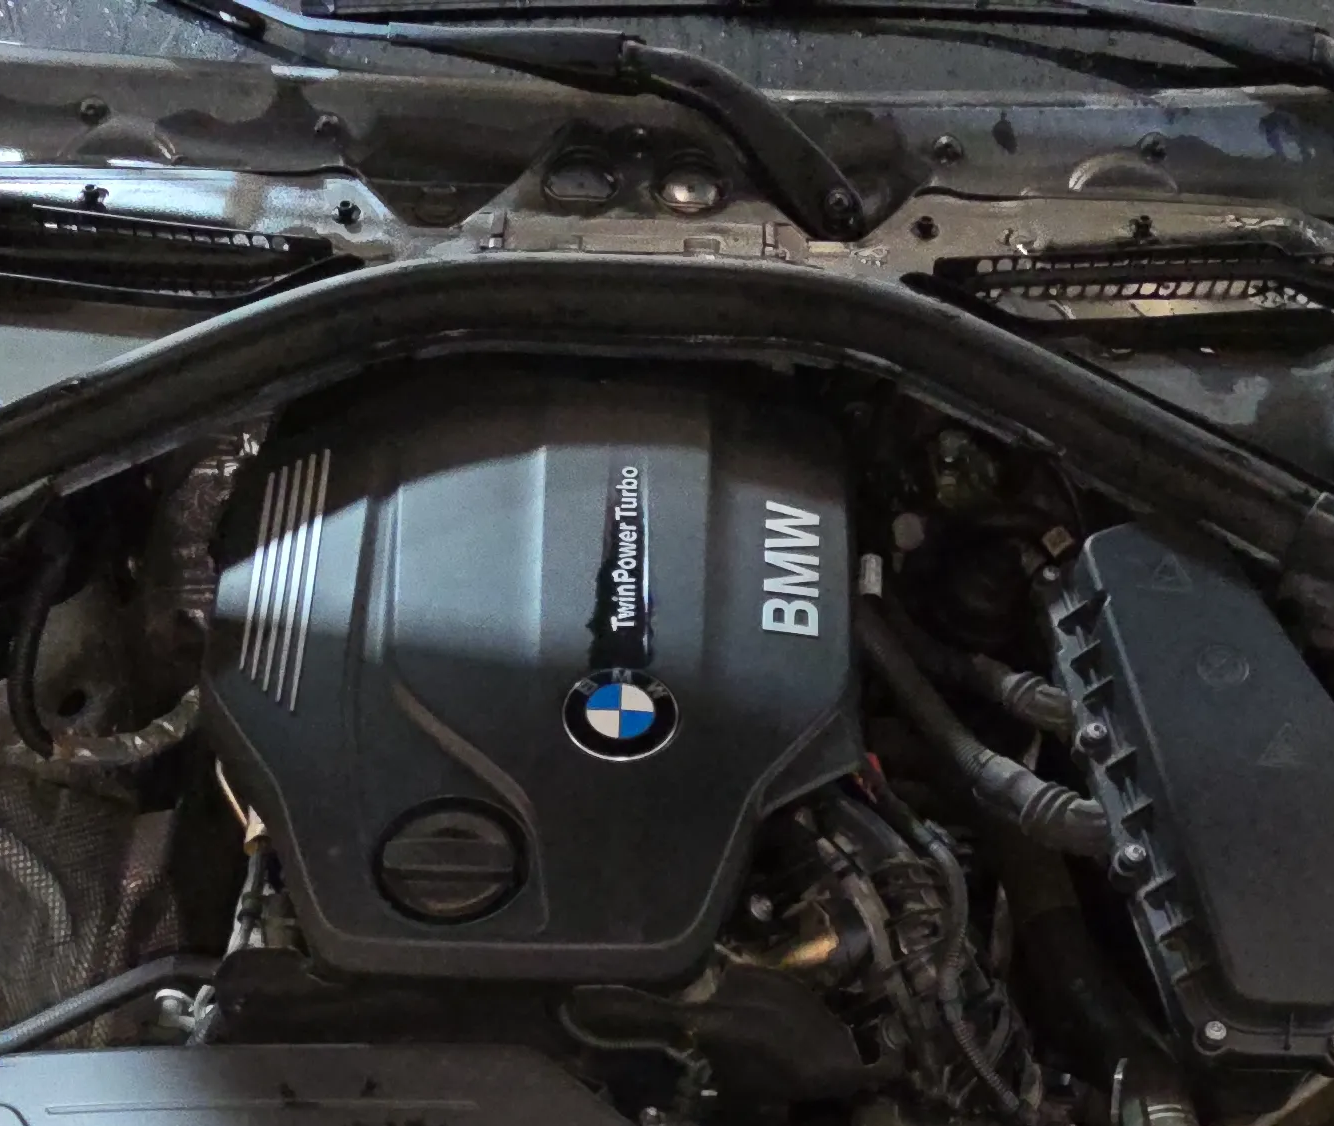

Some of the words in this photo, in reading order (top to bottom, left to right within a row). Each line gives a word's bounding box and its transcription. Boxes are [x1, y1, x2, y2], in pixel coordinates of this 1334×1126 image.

[615, 465, 639, 520] Turbo
[610, 522, 638, 632] TwinPower
[762, 500, 820, 637] BMW
[575, 668, 668, 699] BMW
